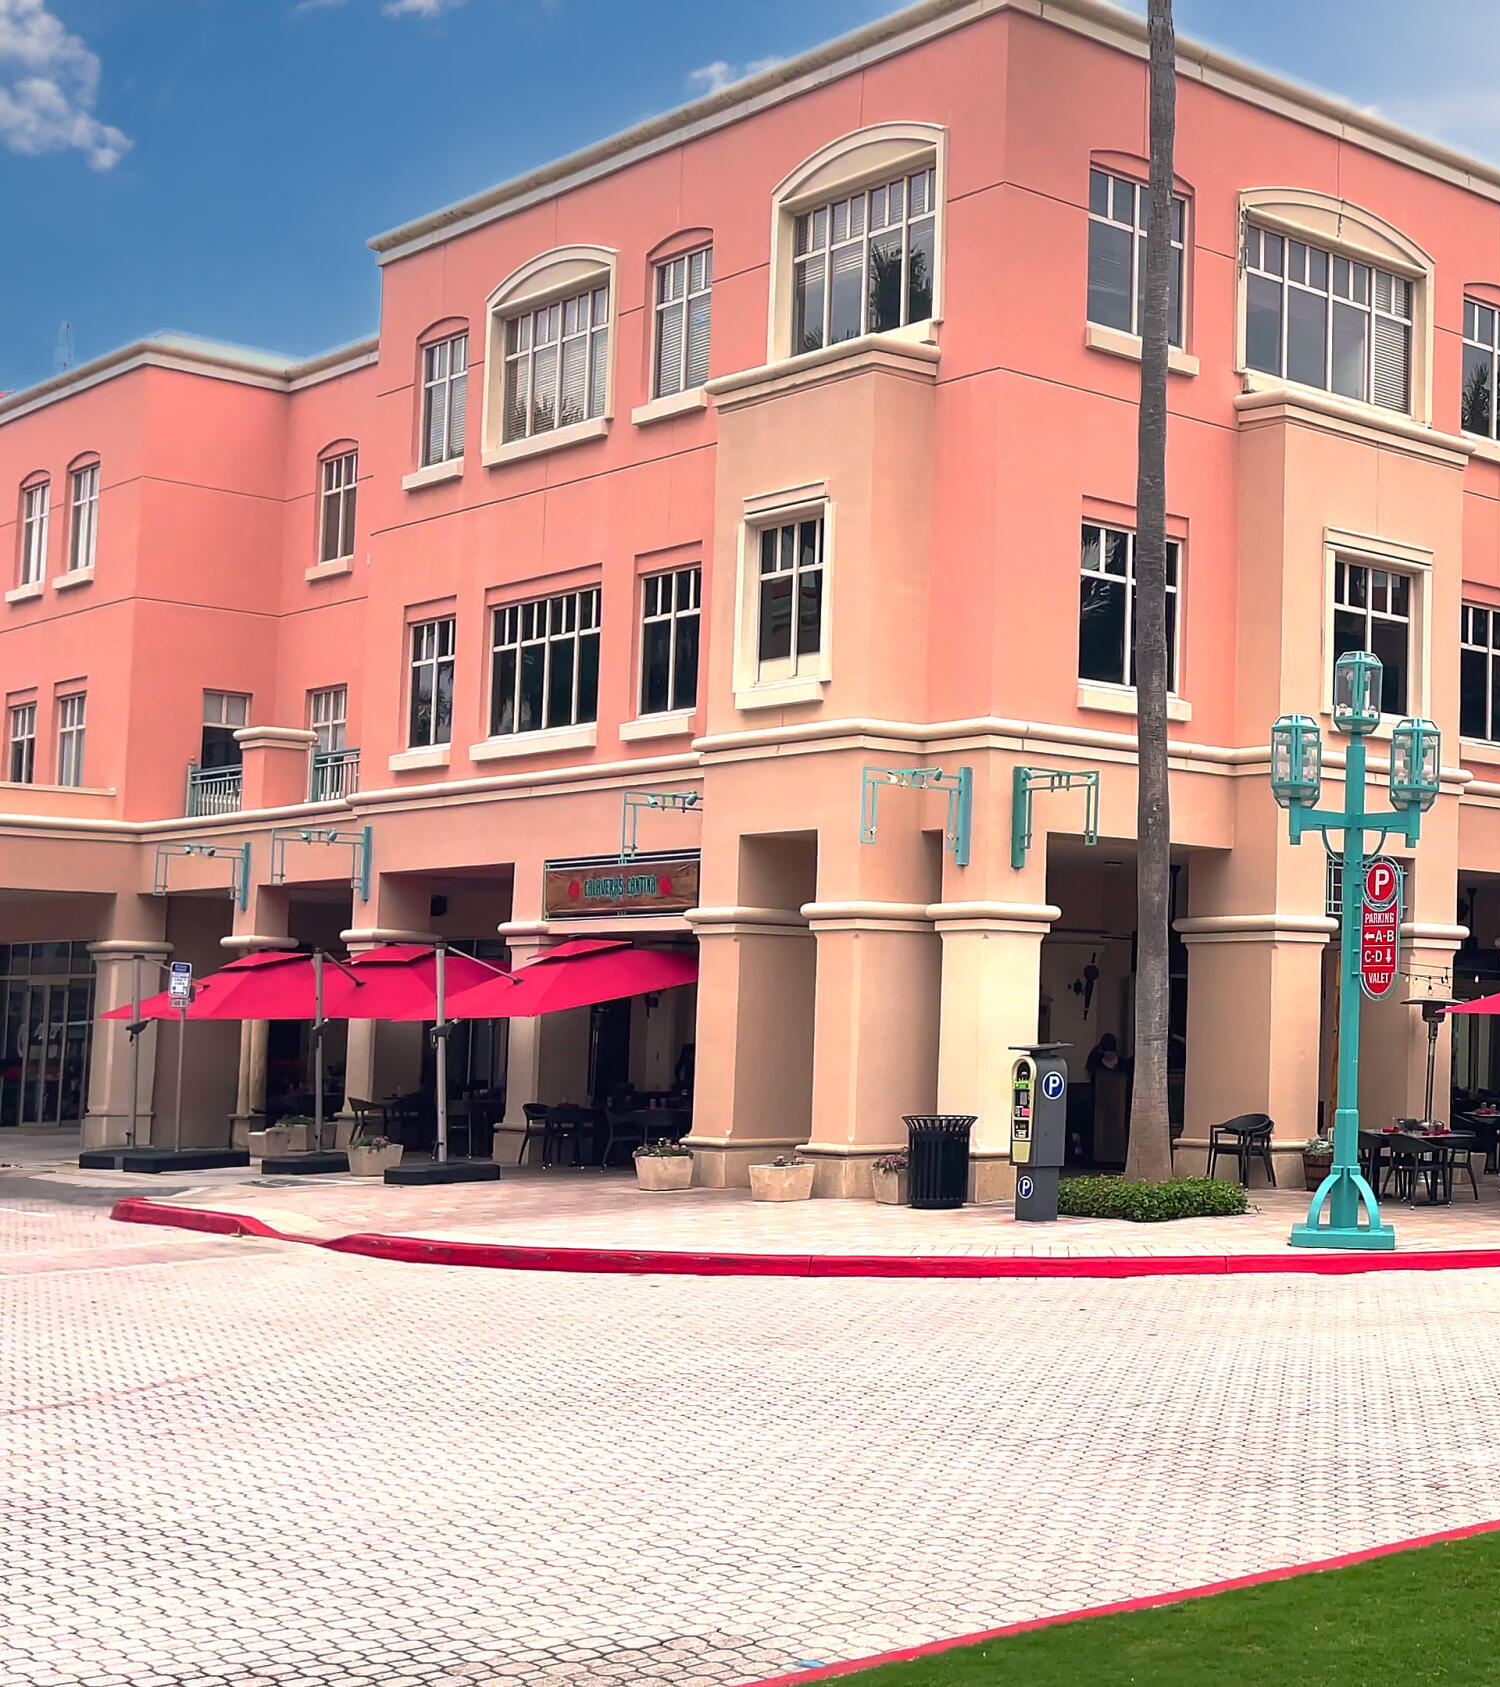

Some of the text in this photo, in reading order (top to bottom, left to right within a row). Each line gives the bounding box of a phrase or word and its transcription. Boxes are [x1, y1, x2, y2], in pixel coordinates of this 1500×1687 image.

[1374, 869, 1390, 896] P
[1364, 912, 1394, 924] PARKING
[1375, 930, 1394, 942] A-B
[1364, 951, 1383, 963] C-D
[1368, 973, 1389, 984] VALET
[1049, 1076, 1060, 1095] P
[1022, 1179, 1030, 1196] P
